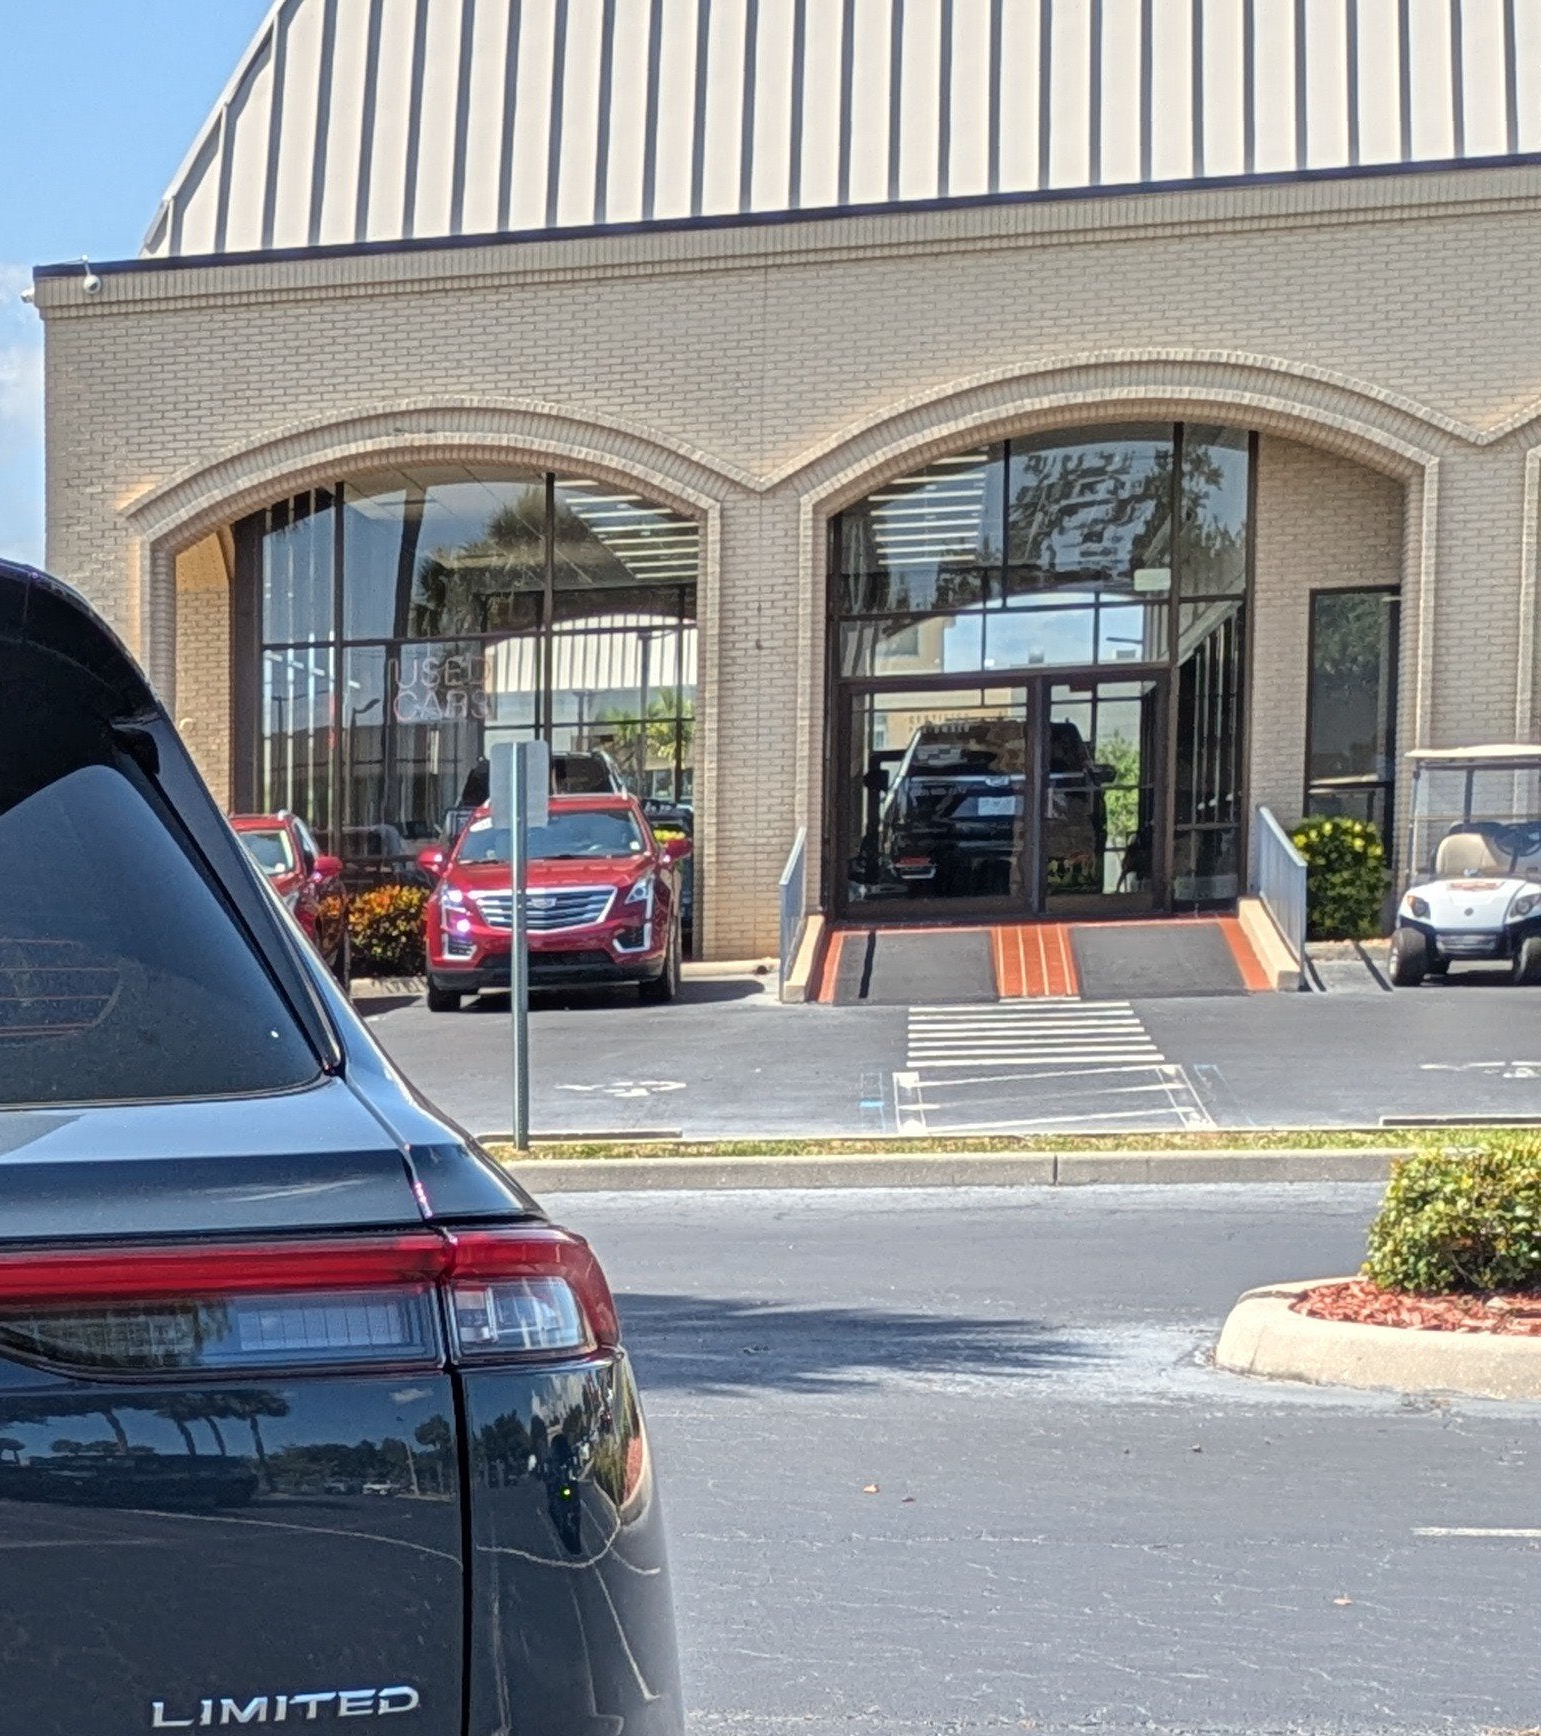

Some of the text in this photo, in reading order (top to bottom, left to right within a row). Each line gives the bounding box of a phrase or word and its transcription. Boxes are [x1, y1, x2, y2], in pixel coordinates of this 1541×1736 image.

[390, 656, 492, 690] USED
[393, 689, 490, 723] CARS
[151, 1685, 421, 1729] LIMITED
